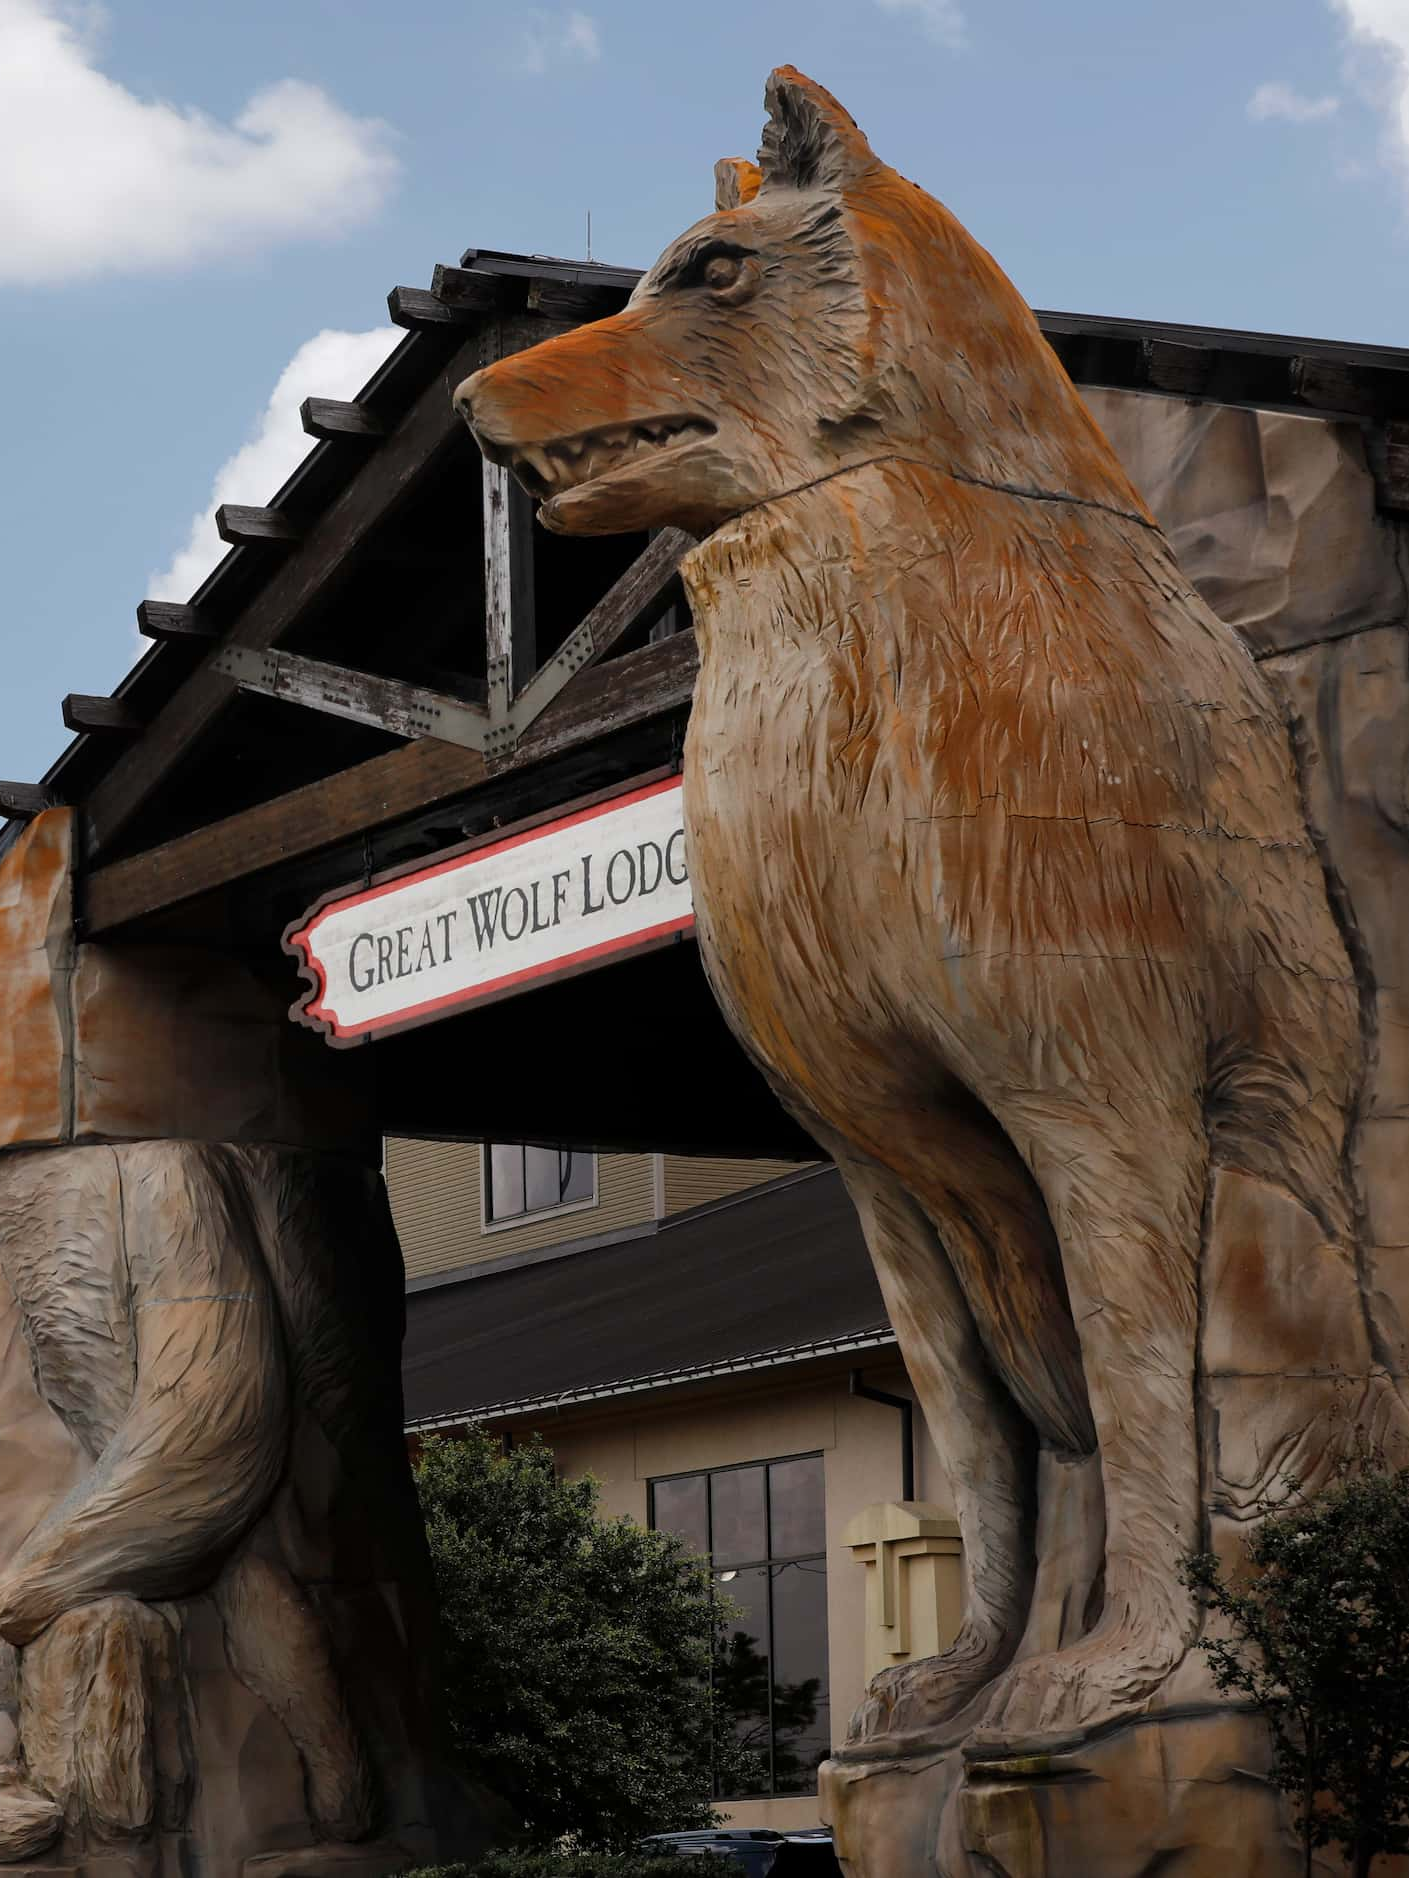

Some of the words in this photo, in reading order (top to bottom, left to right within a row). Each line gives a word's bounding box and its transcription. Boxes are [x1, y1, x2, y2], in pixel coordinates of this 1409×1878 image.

[349, 911, 457, 993] GREAT
[466, 869, 571, 953] WOLF
[580, 828, 689, 917] LODG
